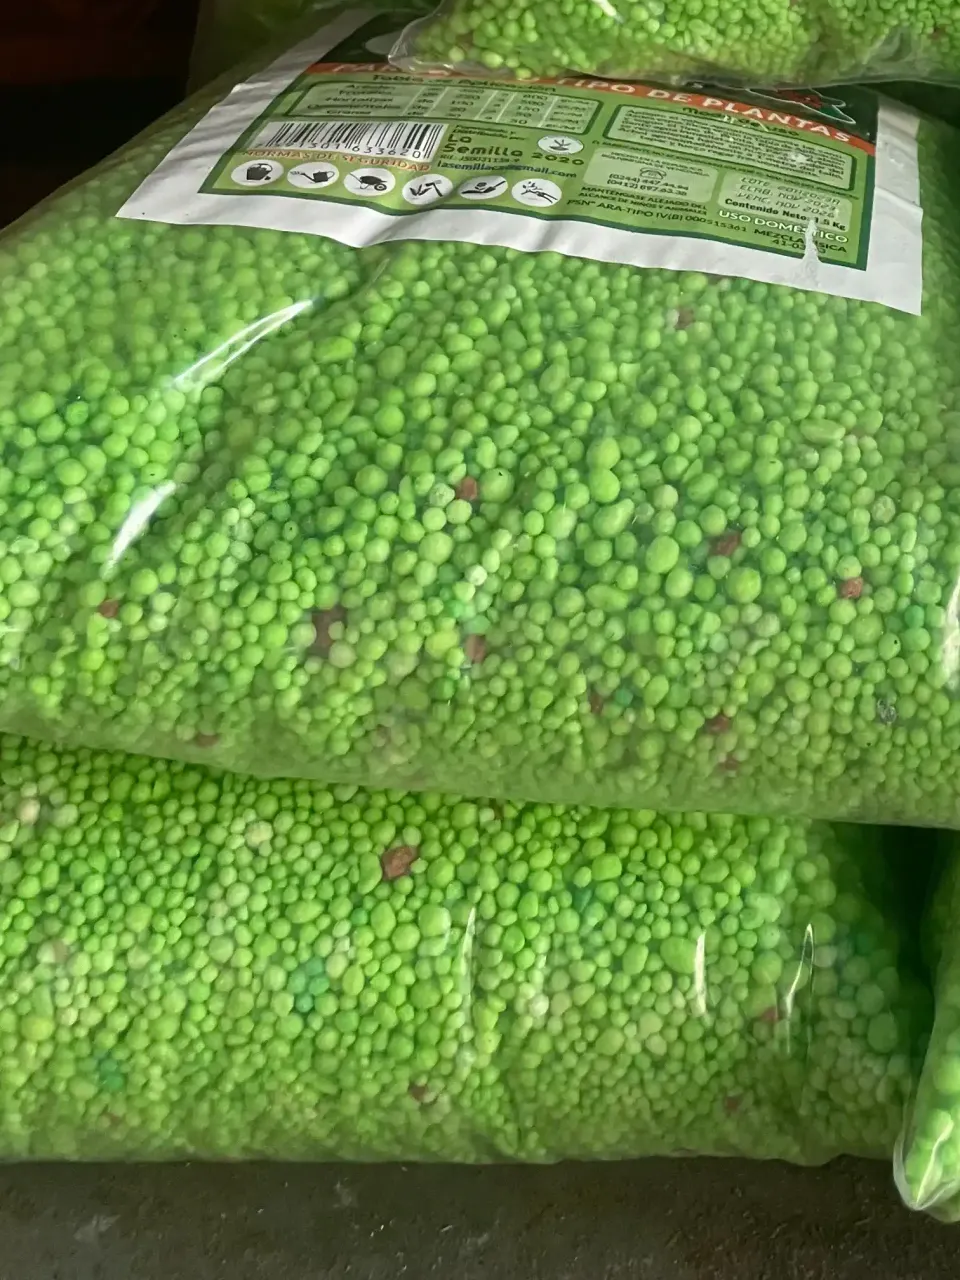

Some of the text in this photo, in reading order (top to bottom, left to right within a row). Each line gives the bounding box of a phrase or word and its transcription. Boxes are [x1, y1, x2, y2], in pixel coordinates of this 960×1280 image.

[647, 89, 693, 102] DE
[703, 98, 850, 142] PLANTAS
[448, 133, 472, 143] La
[352, 146, 421, 159] 633620
[443, 143, 584, 166] Semilla 2020
[243, 149, 431, 171] NORMAS DE SEGURIDAD
[607, 179, 638, 190] (0412)
[609, 173, 640, 183] (0244)
[741, 177, 769, 187] LOTE
[578, 192, 617, 202] ALCANCE
[647, 197, 708, 210] ALEJADO DEL
[778, 192, 801, 201] NOV
[804, 198, 836, 210] 2023
[719, 210, 751, 222] USO
[725, 198, 779, 215] Contenido
[833, 222, 846, 231] Kg
[775, 201, 834, 219] NOV 2026
[597, 203, 804, 244] ARA-TIPO IV(B) 000515361 MEZCLA
